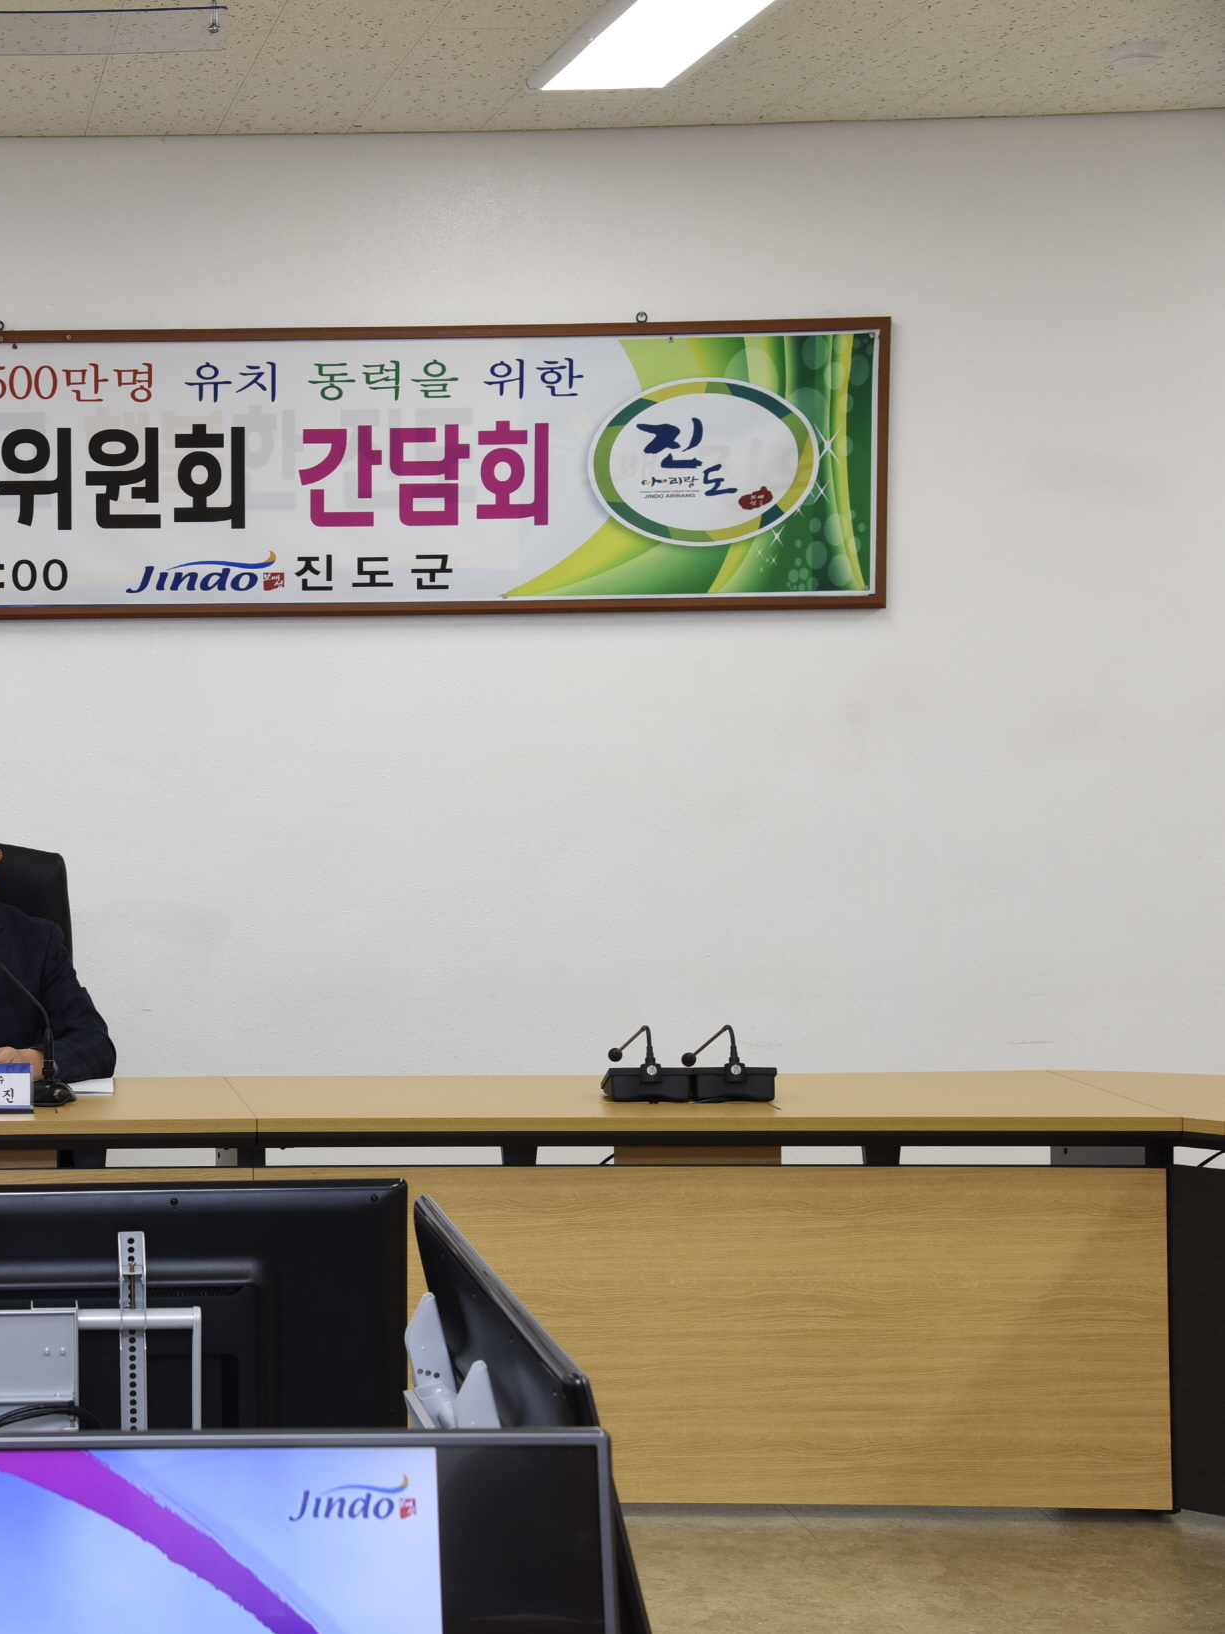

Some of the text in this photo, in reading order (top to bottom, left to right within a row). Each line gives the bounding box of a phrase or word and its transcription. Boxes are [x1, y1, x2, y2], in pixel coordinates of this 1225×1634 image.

[185, 362, 276, 402] 유치
[308, 360, 458, 400] 동력을
[484, 358, 583, 399] 위한
[299, 421, 549, 527] 간담회
[126, 566, 258, 593] Jindo
[295, 555, 452, 591] 진도군
[289, 1489, 395, 1521] Jindo
